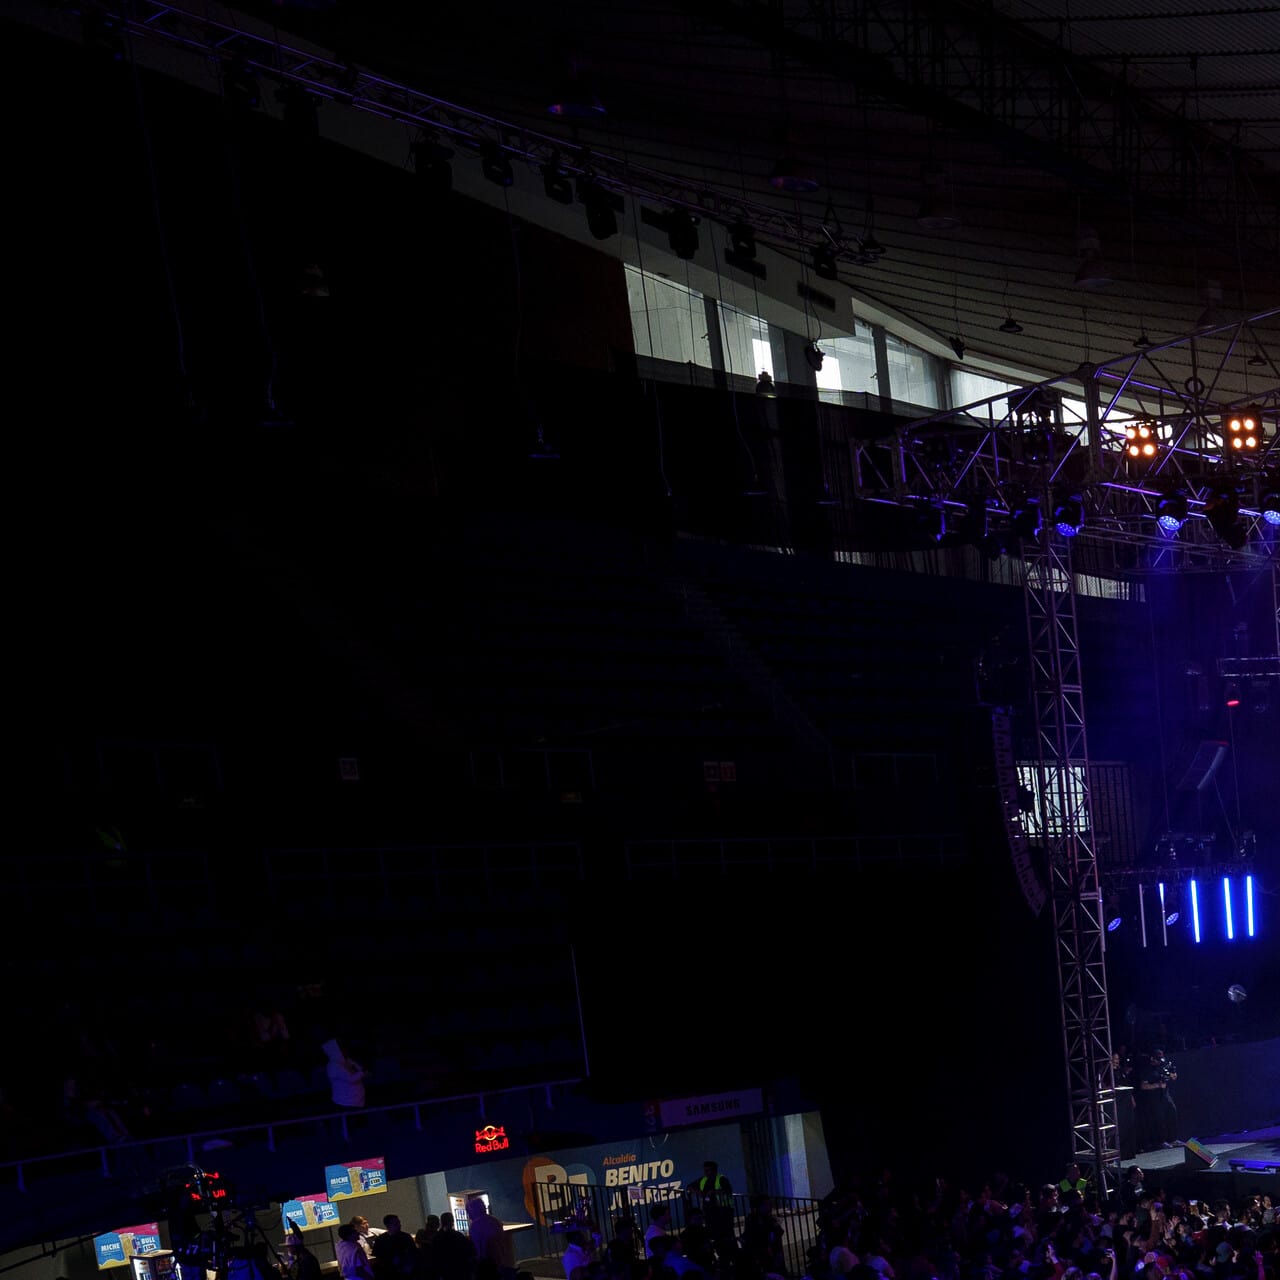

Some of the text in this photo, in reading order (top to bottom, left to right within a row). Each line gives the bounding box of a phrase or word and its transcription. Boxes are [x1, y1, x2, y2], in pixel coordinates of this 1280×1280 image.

[685, 1098, 740, 1117] SAMSUNG
[475, 1137, 509, 1153] Red Bull
[605, 1159, 675, 1187] BENITO
